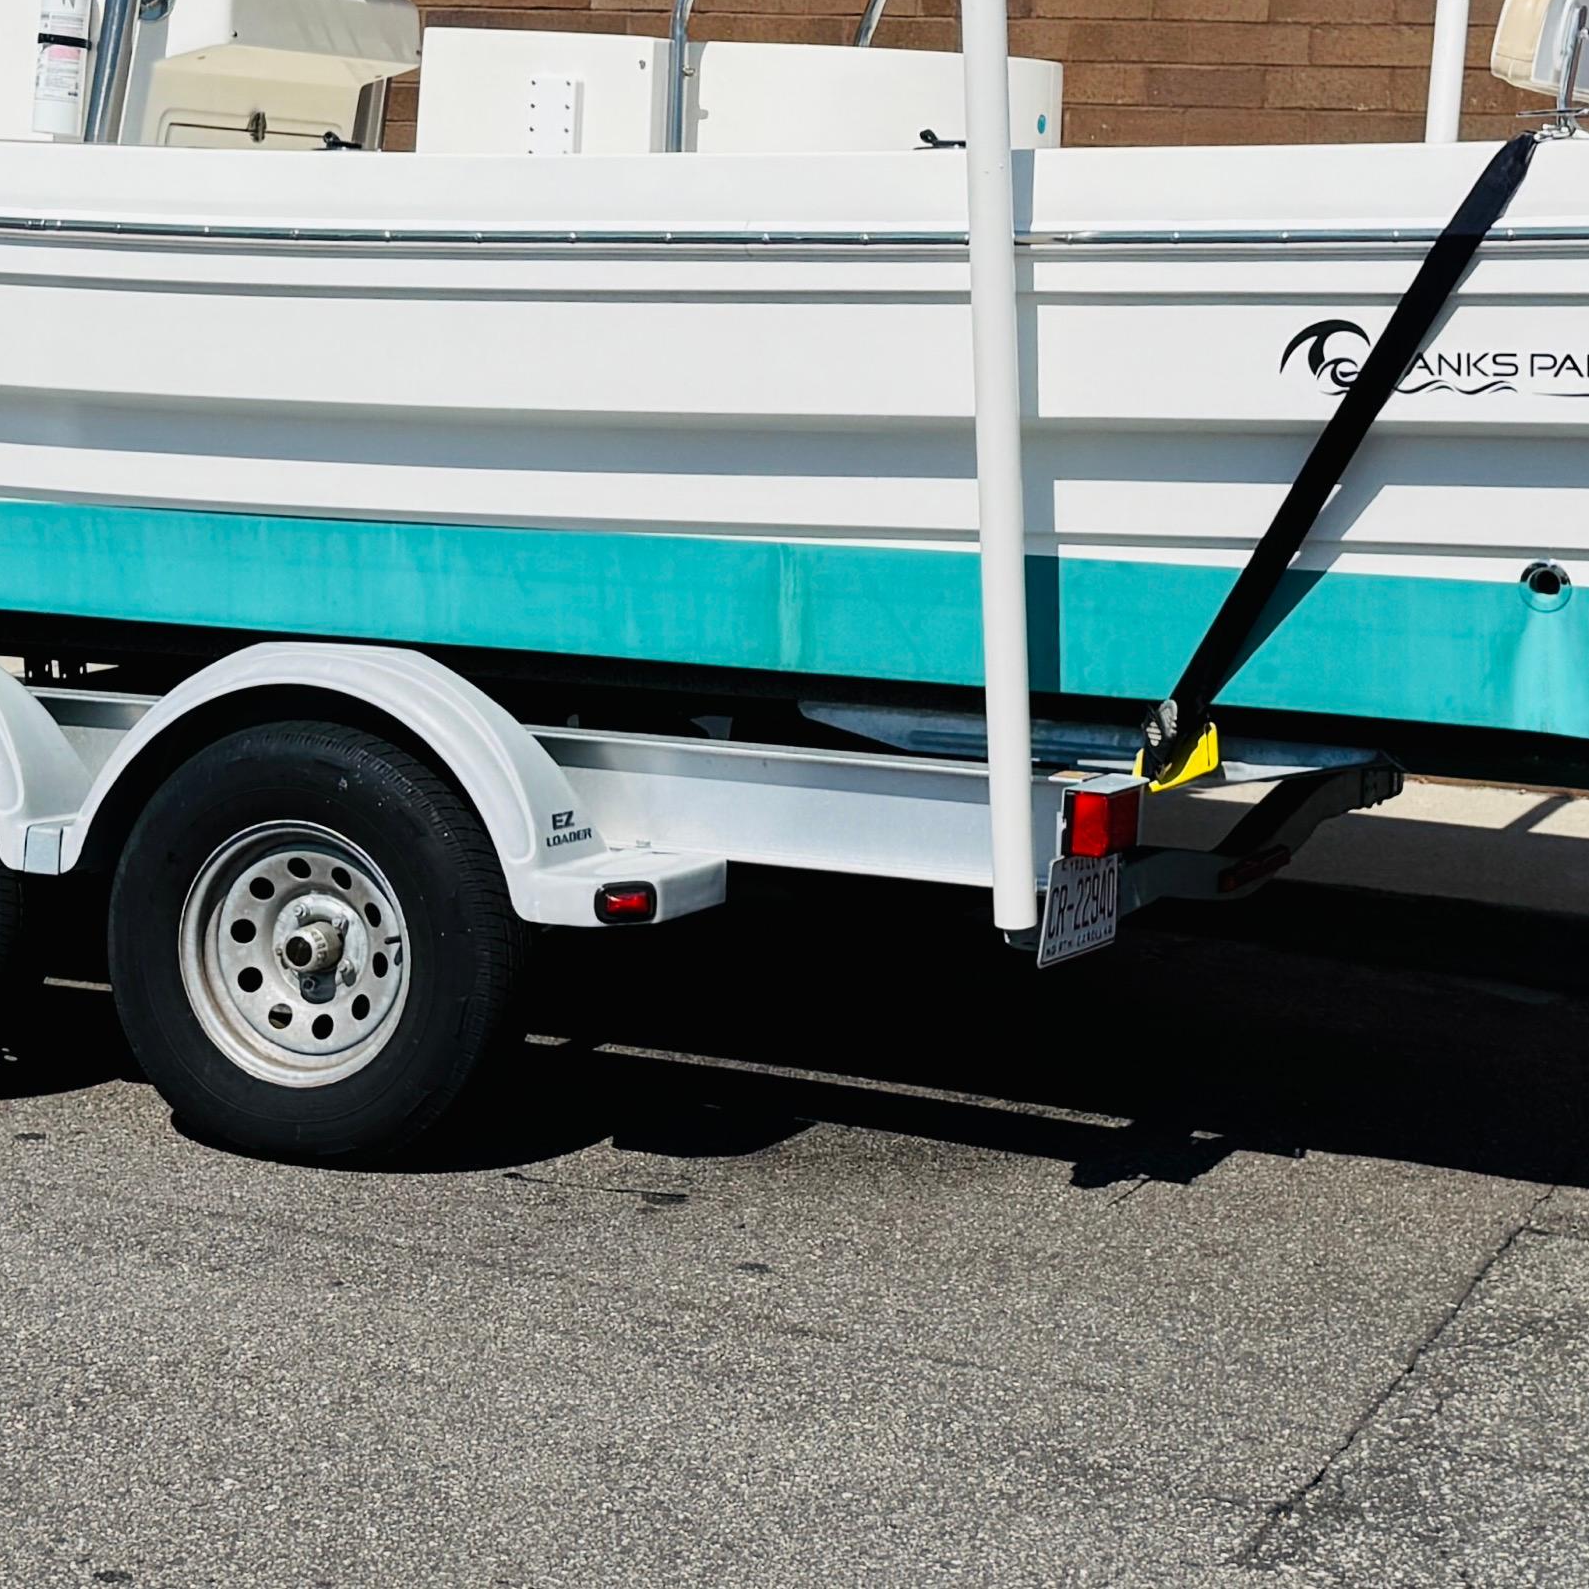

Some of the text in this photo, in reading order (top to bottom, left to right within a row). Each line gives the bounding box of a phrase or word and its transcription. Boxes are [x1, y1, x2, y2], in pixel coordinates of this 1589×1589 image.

[1406, 352, 1519, 377] ANKS
[552, 810, 575, 831] EZ
[546, 827, 592, 848] LOADER
[1047, 867, 1115, 939] CR-22940
